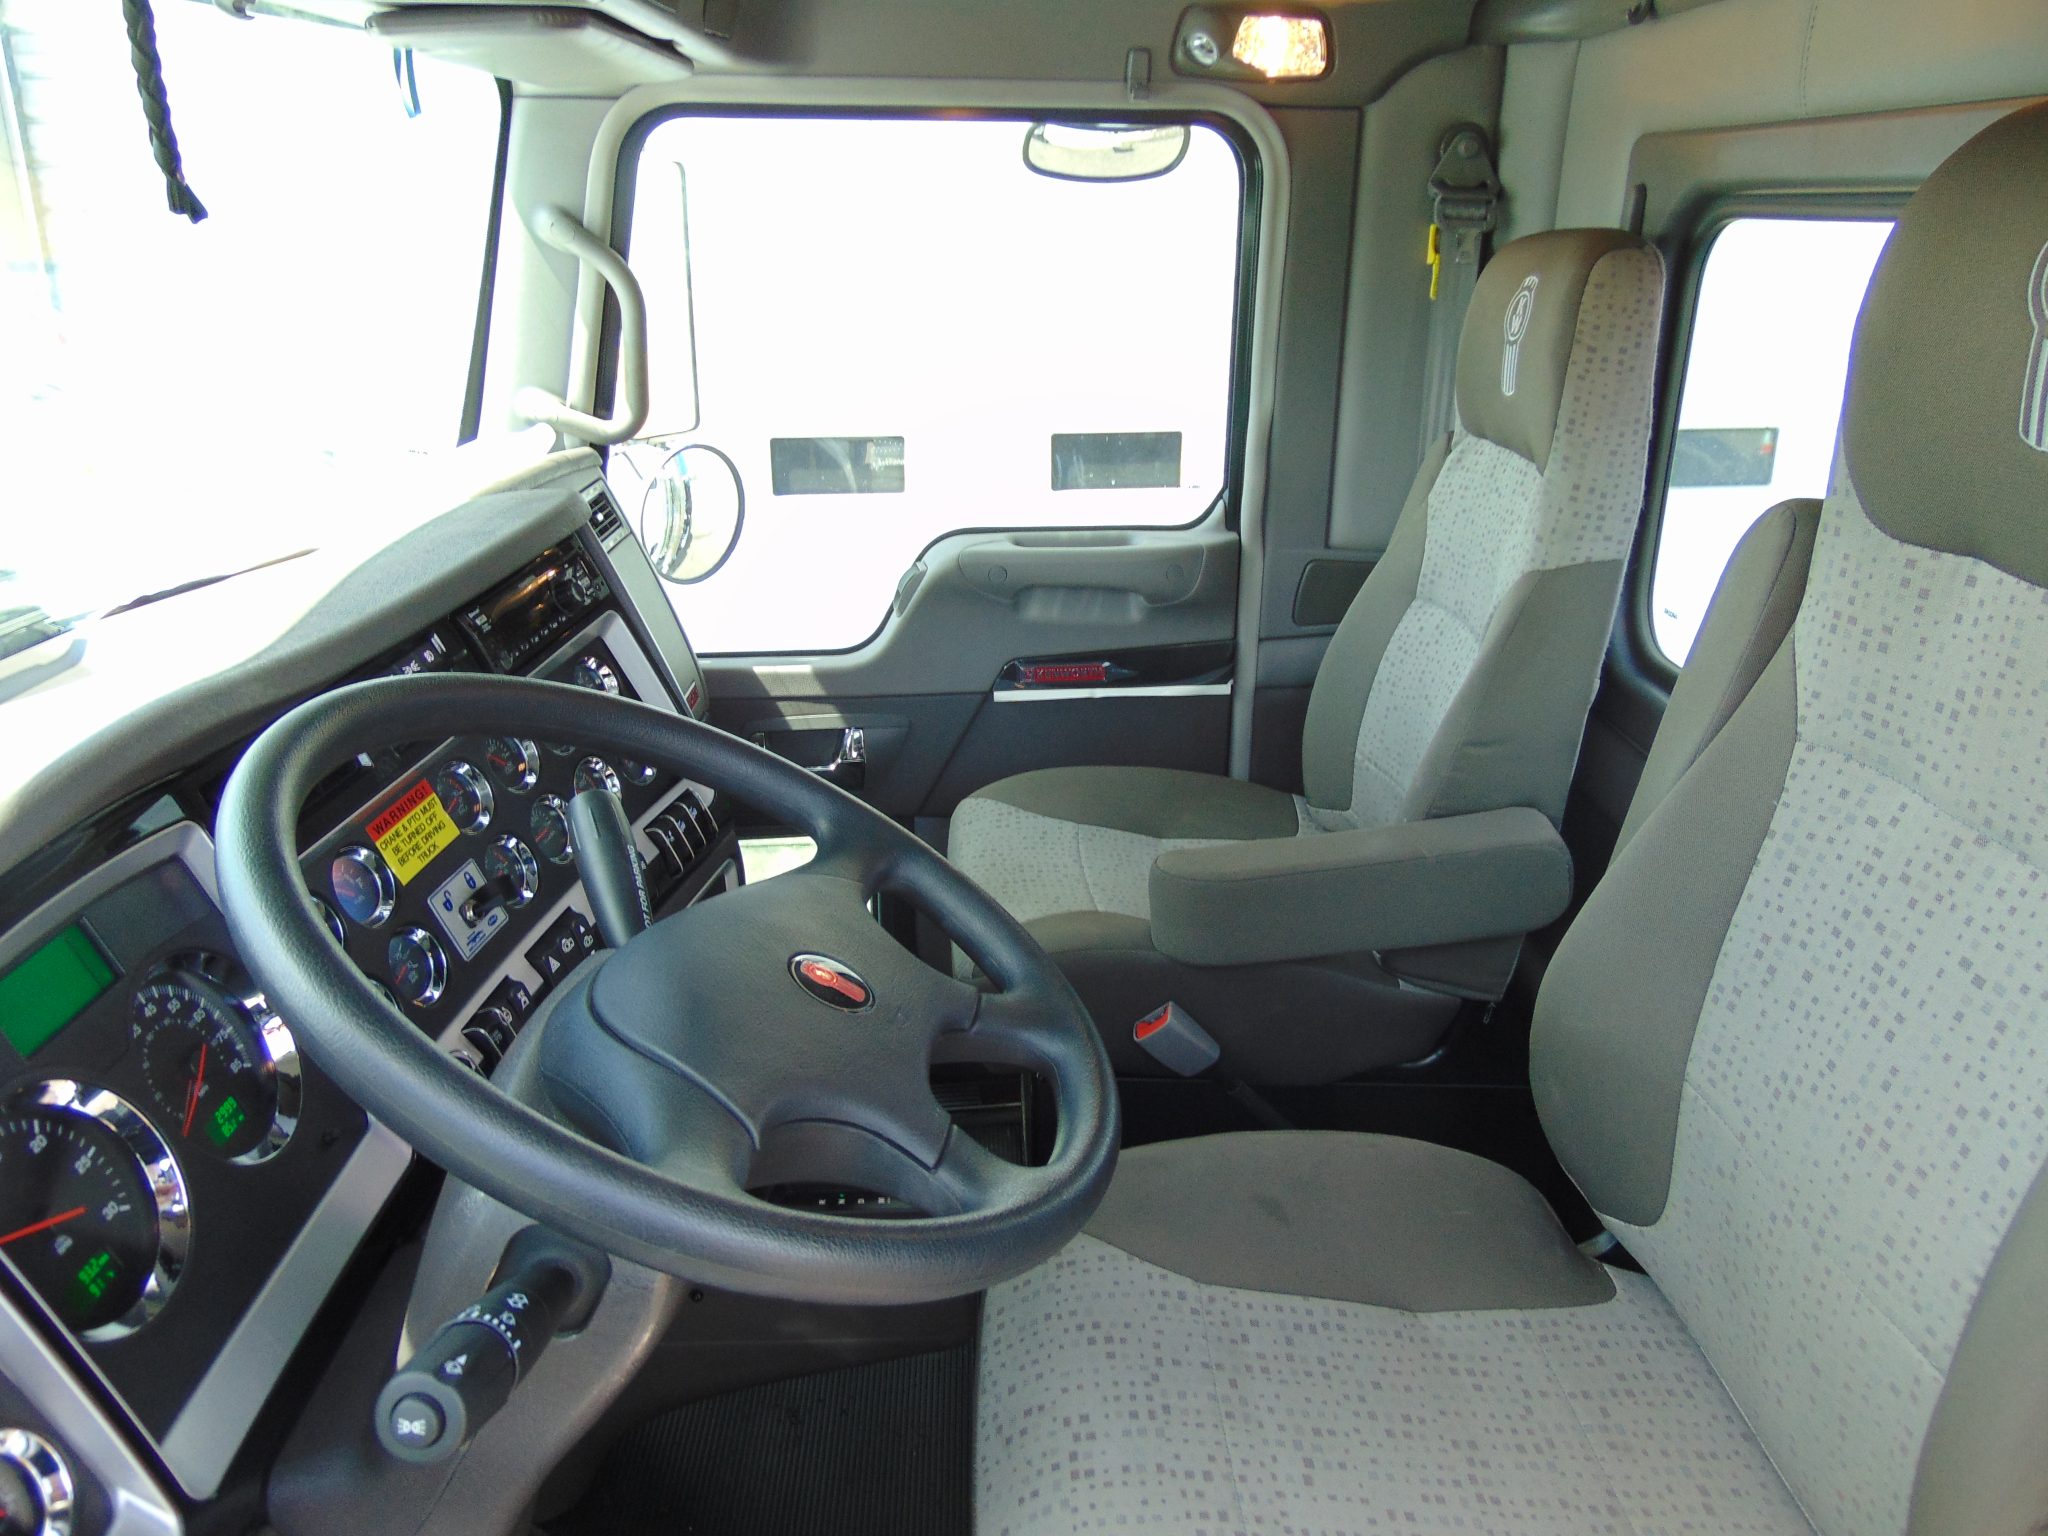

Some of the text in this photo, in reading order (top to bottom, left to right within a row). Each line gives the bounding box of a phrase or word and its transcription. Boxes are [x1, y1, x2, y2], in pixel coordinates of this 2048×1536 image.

[373, 785, 429, 835] WARNING!
[379, 827, 404, 852] CRANE
[408, 812, 421, 827] PTO
[419, 797, 438, 814] MUST
[391, 812, 438, 855] BE TURNED OFF
[398, 820, 446, 867] BEFORE DRIVING
[416, 842, 439, 865] TRUCK
[627, 844, 645, 889] PARKING
[638, 889, 650, 912] FOR
